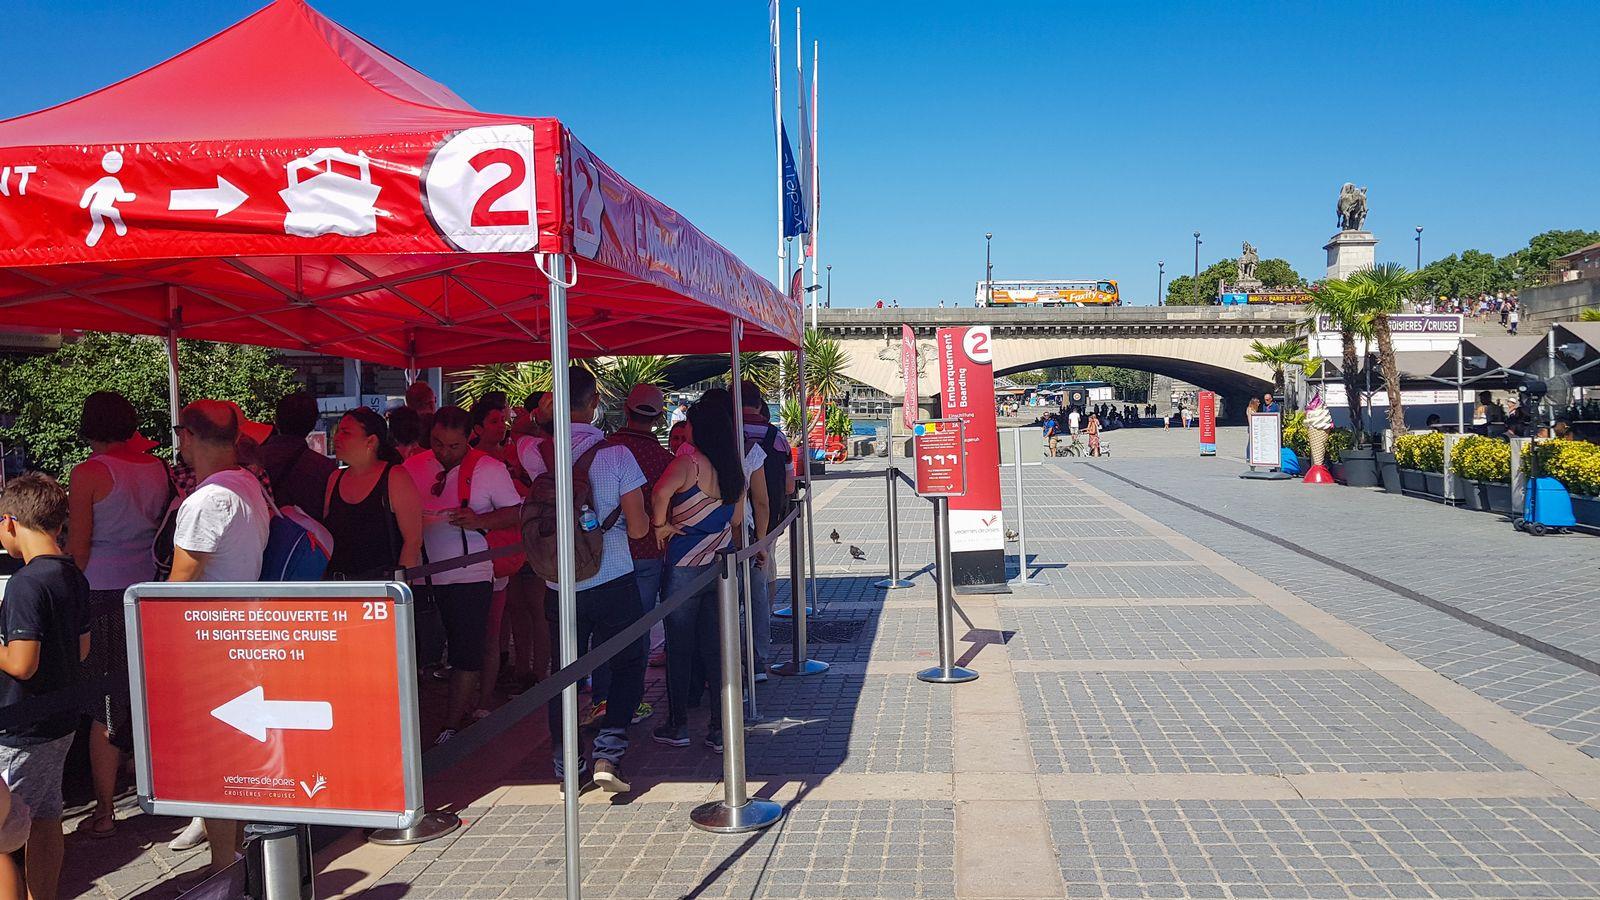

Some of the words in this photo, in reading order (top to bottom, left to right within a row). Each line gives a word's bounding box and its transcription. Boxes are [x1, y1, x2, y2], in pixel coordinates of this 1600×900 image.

[466, 147, 530, 228] 2
[574, 157, 596, 236] 2
[971, 332, 989, 355] 2
[943, 334, 956, 408] Embarquement
[958, 367, 968, 408] Boarding
[184, 607, 245, 622] CROISIÈRE
[248, 607, 329, 622] DÉCOUVERTE
[332, 610, 348, 622] 1H
[362, 602, 388, 620] 2B
[195, 629, 210, 641] 1H
[212, 629, 290, 641] SIGHTSEEING
[293, 630, 338, 641] CRUISE
[228, 648, 287, 661] CRUCERO
[289, 649, 305, 661] 1H
